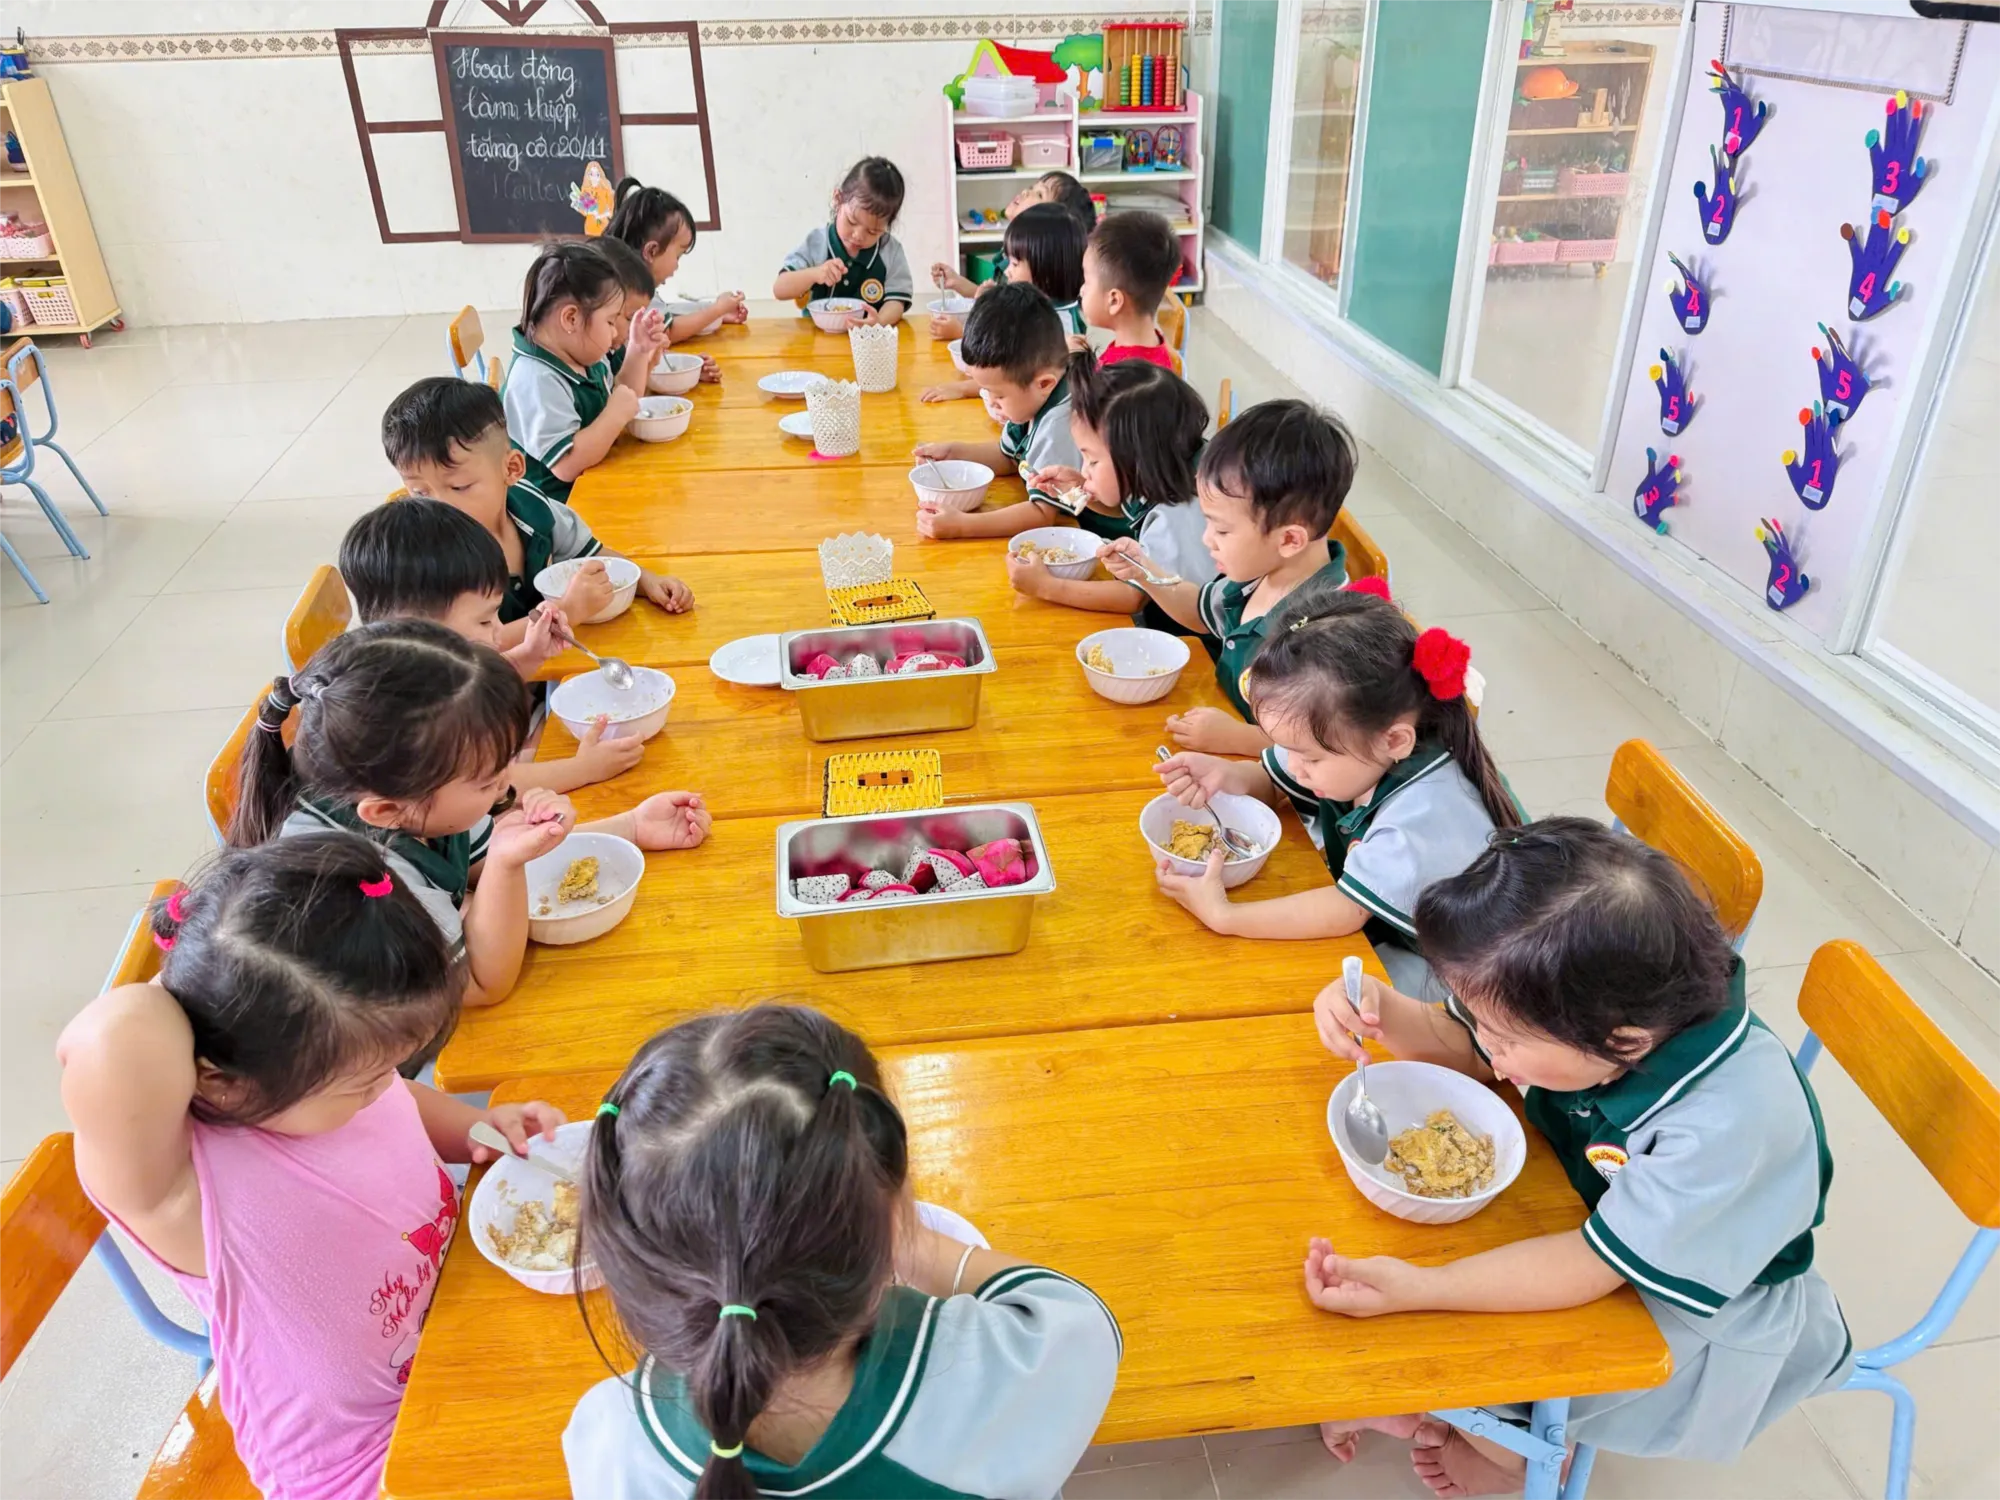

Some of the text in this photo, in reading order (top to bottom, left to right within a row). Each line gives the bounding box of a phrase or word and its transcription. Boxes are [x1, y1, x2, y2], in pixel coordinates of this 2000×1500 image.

[453, 47, 576, 98] Hoạt động
[524, 86, 578, 131] thiệp
[1882, 161, 1900, 193] 3
[1713, 195, 1725, 223] 2
[1859, 272, 1875, 302] 4
[1835, 370, 1852, 400] 5
[1667, 396, 1679, 421] 5
[1808, 459, 1822, 488] 1
[1774, 564, 1790, 592] 2
[369, 1270, 403, 1315] My
